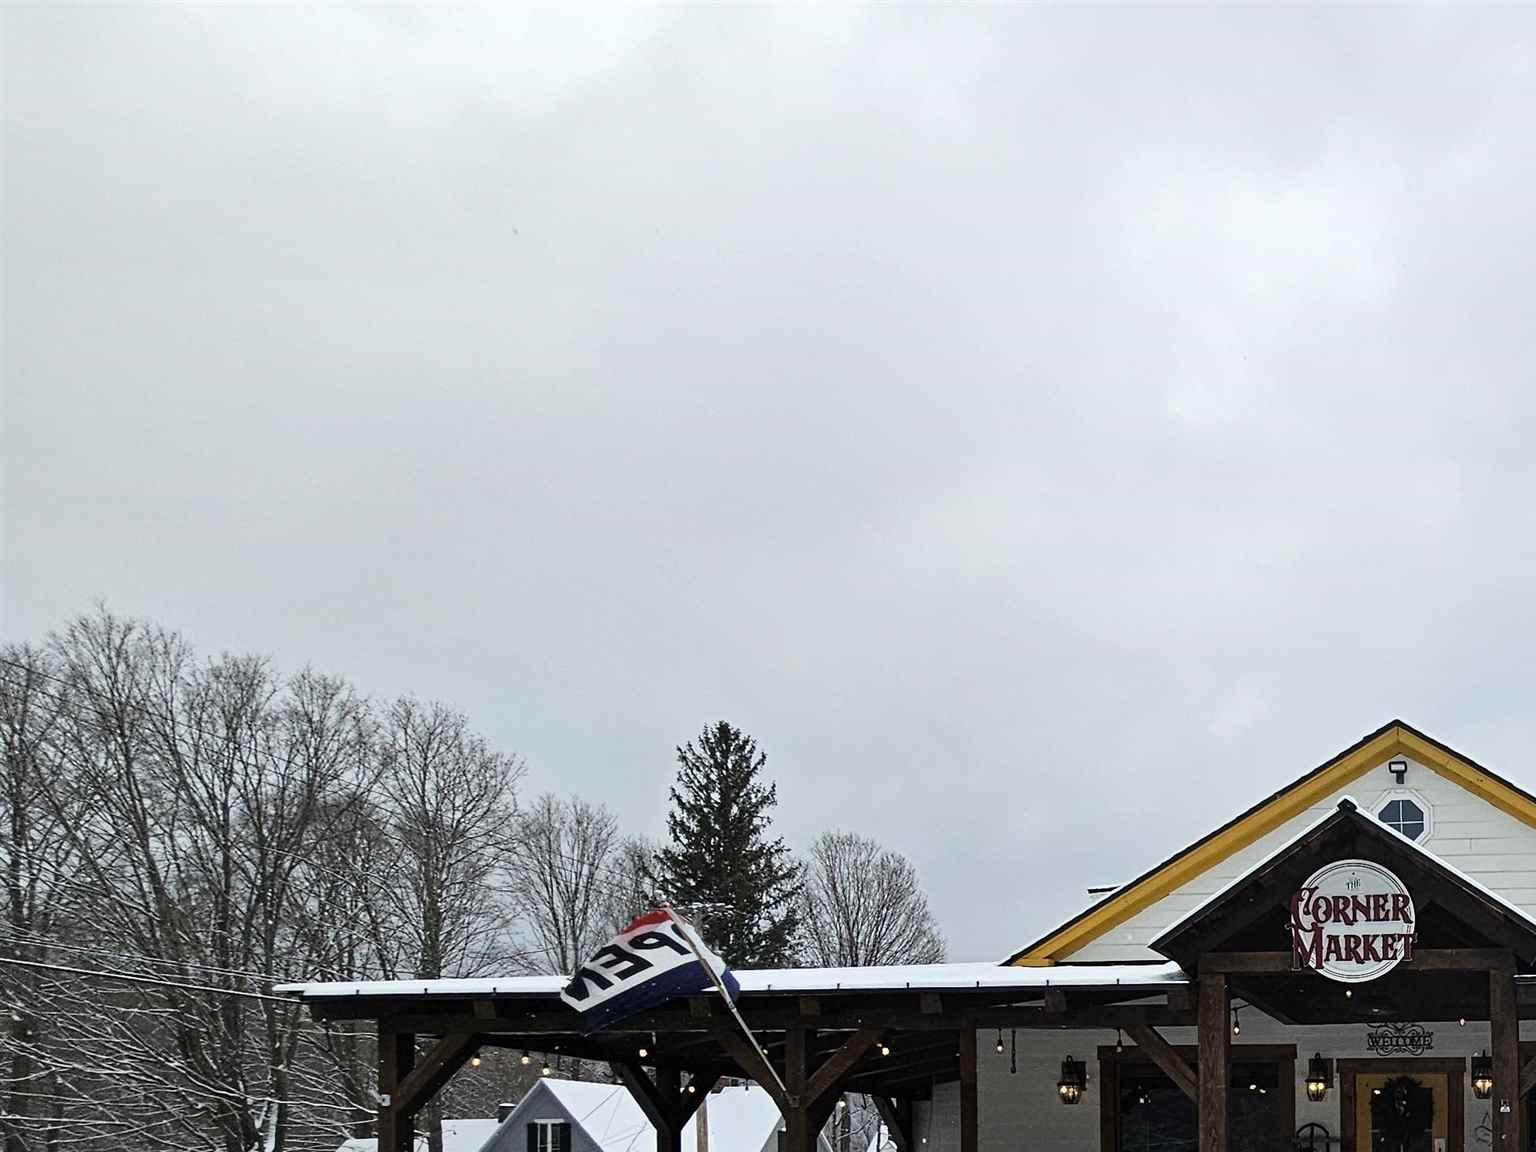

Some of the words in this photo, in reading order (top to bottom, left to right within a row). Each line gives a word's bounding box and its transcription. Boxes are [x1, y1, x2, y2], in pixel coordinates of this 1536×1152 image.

[1285, 886, 1414, 932] CORNER
[1291, 923, 1418, 971] MARKET
[1367, 1032, 1434, 1050] WELCOME
